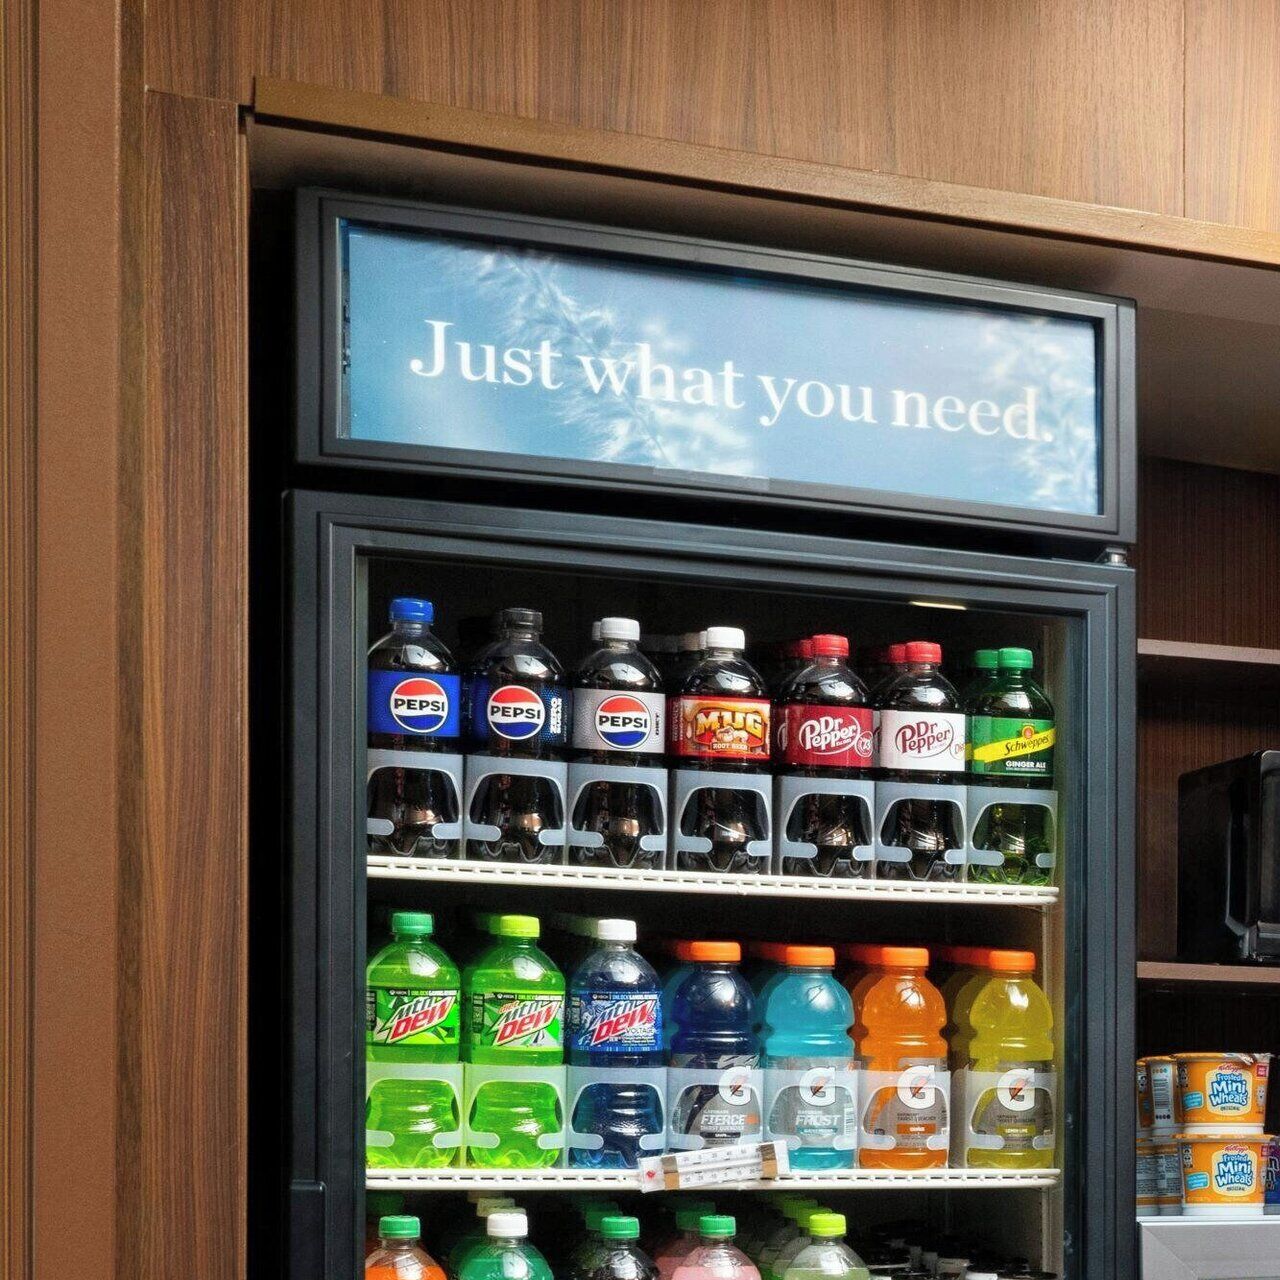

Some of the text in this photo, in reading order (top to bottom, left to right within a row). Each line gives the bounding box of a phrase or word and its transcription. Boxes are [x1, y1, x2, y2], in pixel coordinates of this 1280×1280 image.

[410, 319, 1054, 443] Just what you need.
[394, 698, 446, 713] PEPSI
[490, 706, 541, 721] PEPSI
[599, 714, 649, 729] PEPSI
[696, 711, 763, 734] MUG
[820, 716, 841, 732] Dr
[917, 721, 937, 736] Dr
[803, 719, 857, 752] Pepper
[896, 724, 950, 754] Pepper
[1006, 760, 1034, 768] GINGER
[719, 1066, 751, 1106] G
[799, 1067, 836, 1107] G
[896, 1065, 935, 1109] G
[996, 1068, 1036, 1111] G
[1213, 1080, 1246, 1094] Mini
[1210, 1093, 1248, 1106] Wheats
[701, 1115, 747, 1126] FIERCE
[1219, 1162, 1252, 1175] Mini
[1215, 1174, 1252, 1185] Wheats
